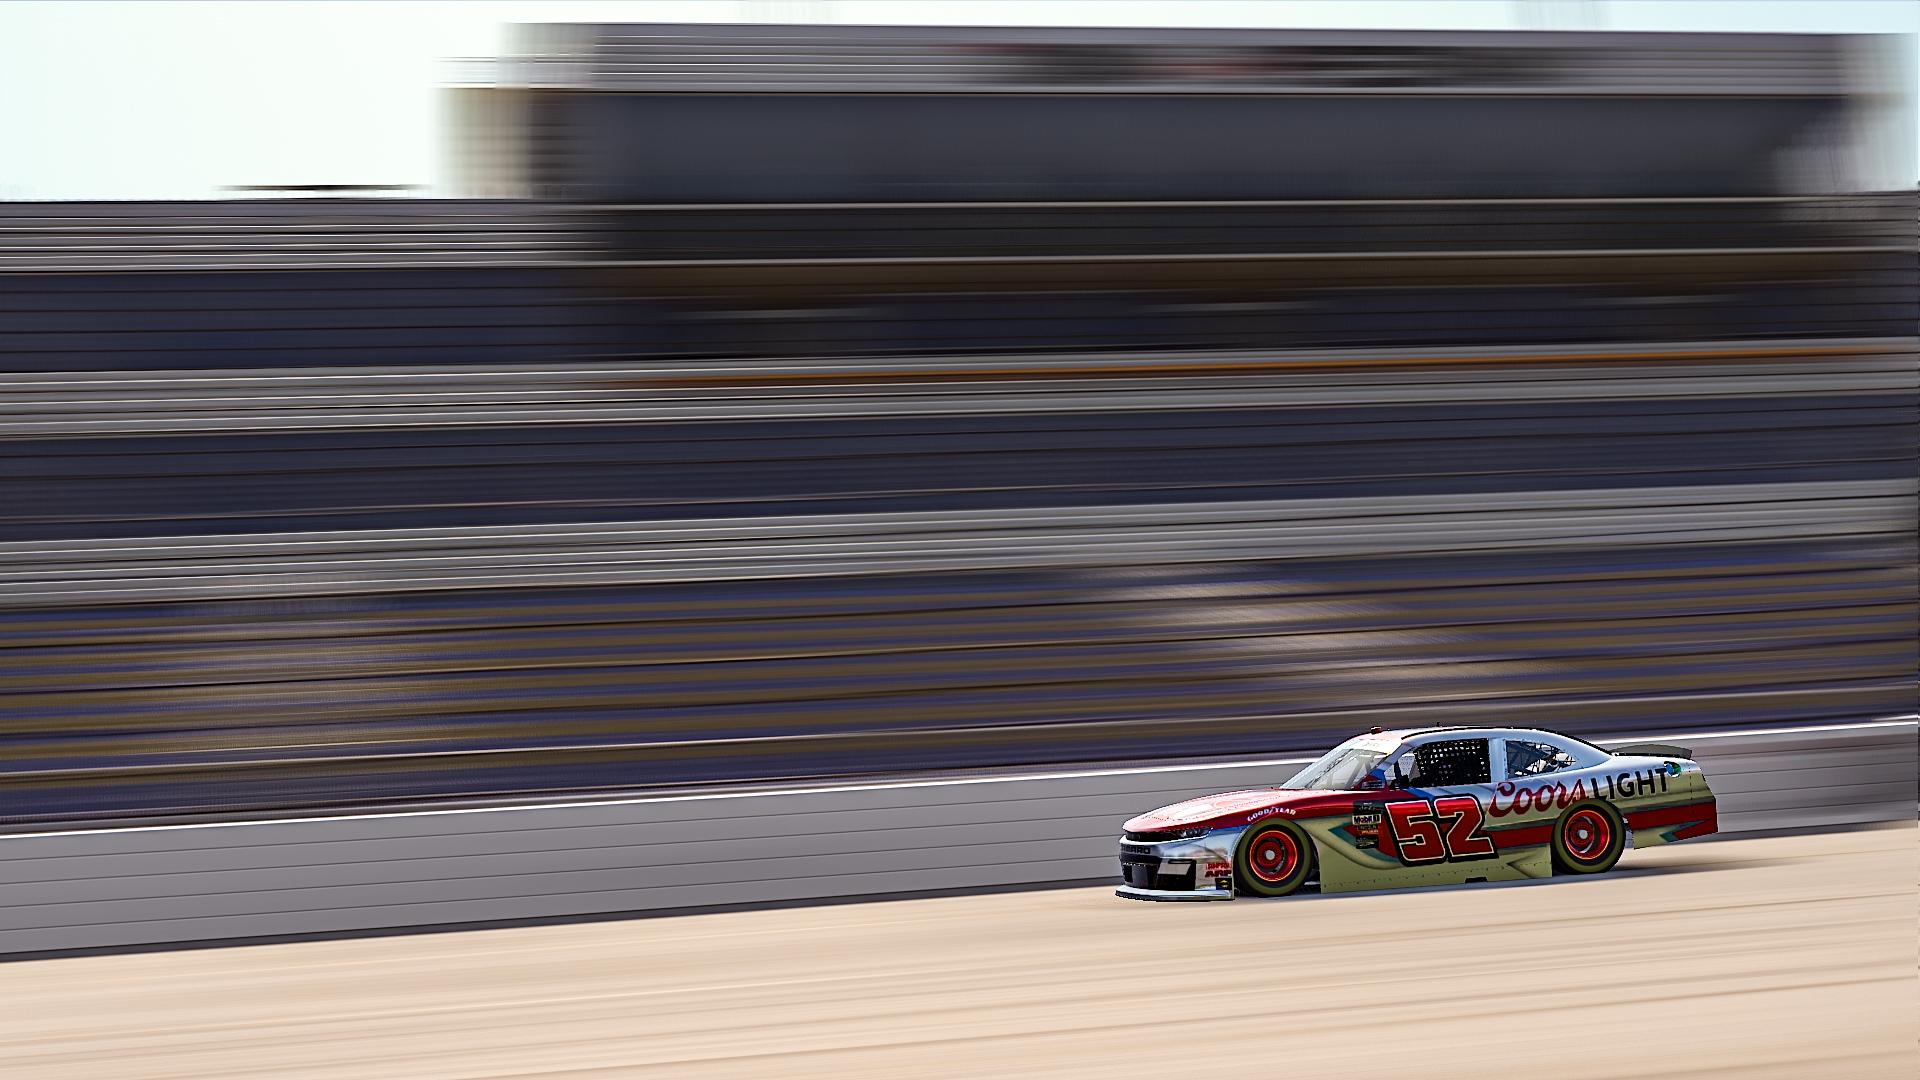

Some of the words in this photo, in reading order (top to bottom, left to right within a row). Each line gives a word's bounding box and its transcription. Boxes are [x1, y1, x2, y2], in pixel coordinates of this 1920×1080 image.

[1247, 806, 1297, 821] GOODYEAR
[1488, 779, 1590, 817] Coors
[1590, 768, 1667, 801] LIGHT
[1384, 795, 1495, 862] 52
